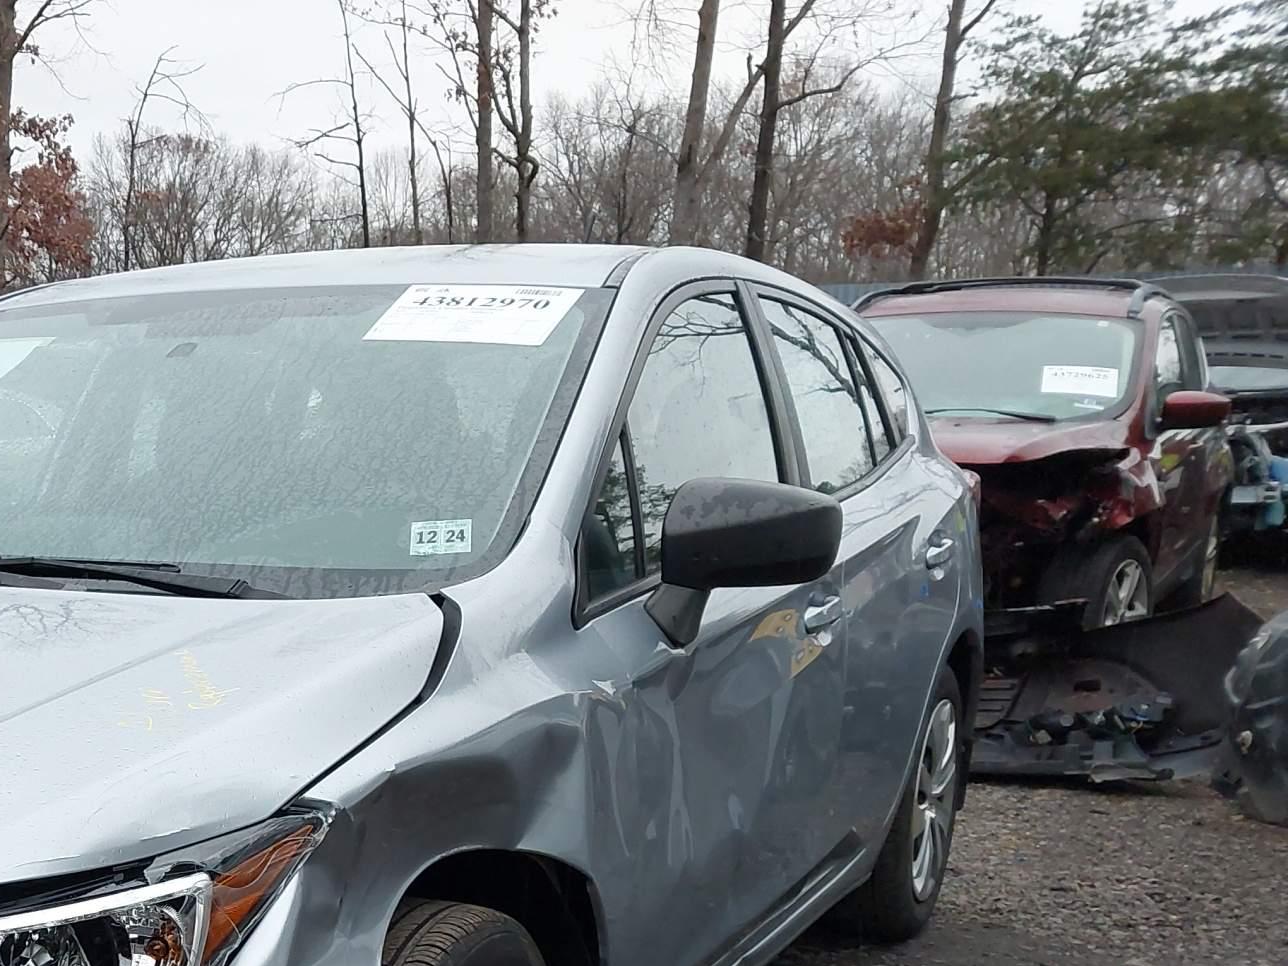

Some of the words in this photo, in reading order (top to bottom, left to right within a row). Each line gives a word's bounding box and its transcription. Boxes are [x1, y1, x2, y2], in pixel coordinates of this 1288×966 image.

[413, 295, 551, 310] 43812970
[416, 530, 438, 544] 12
[445, 529, 466, 543] 24
